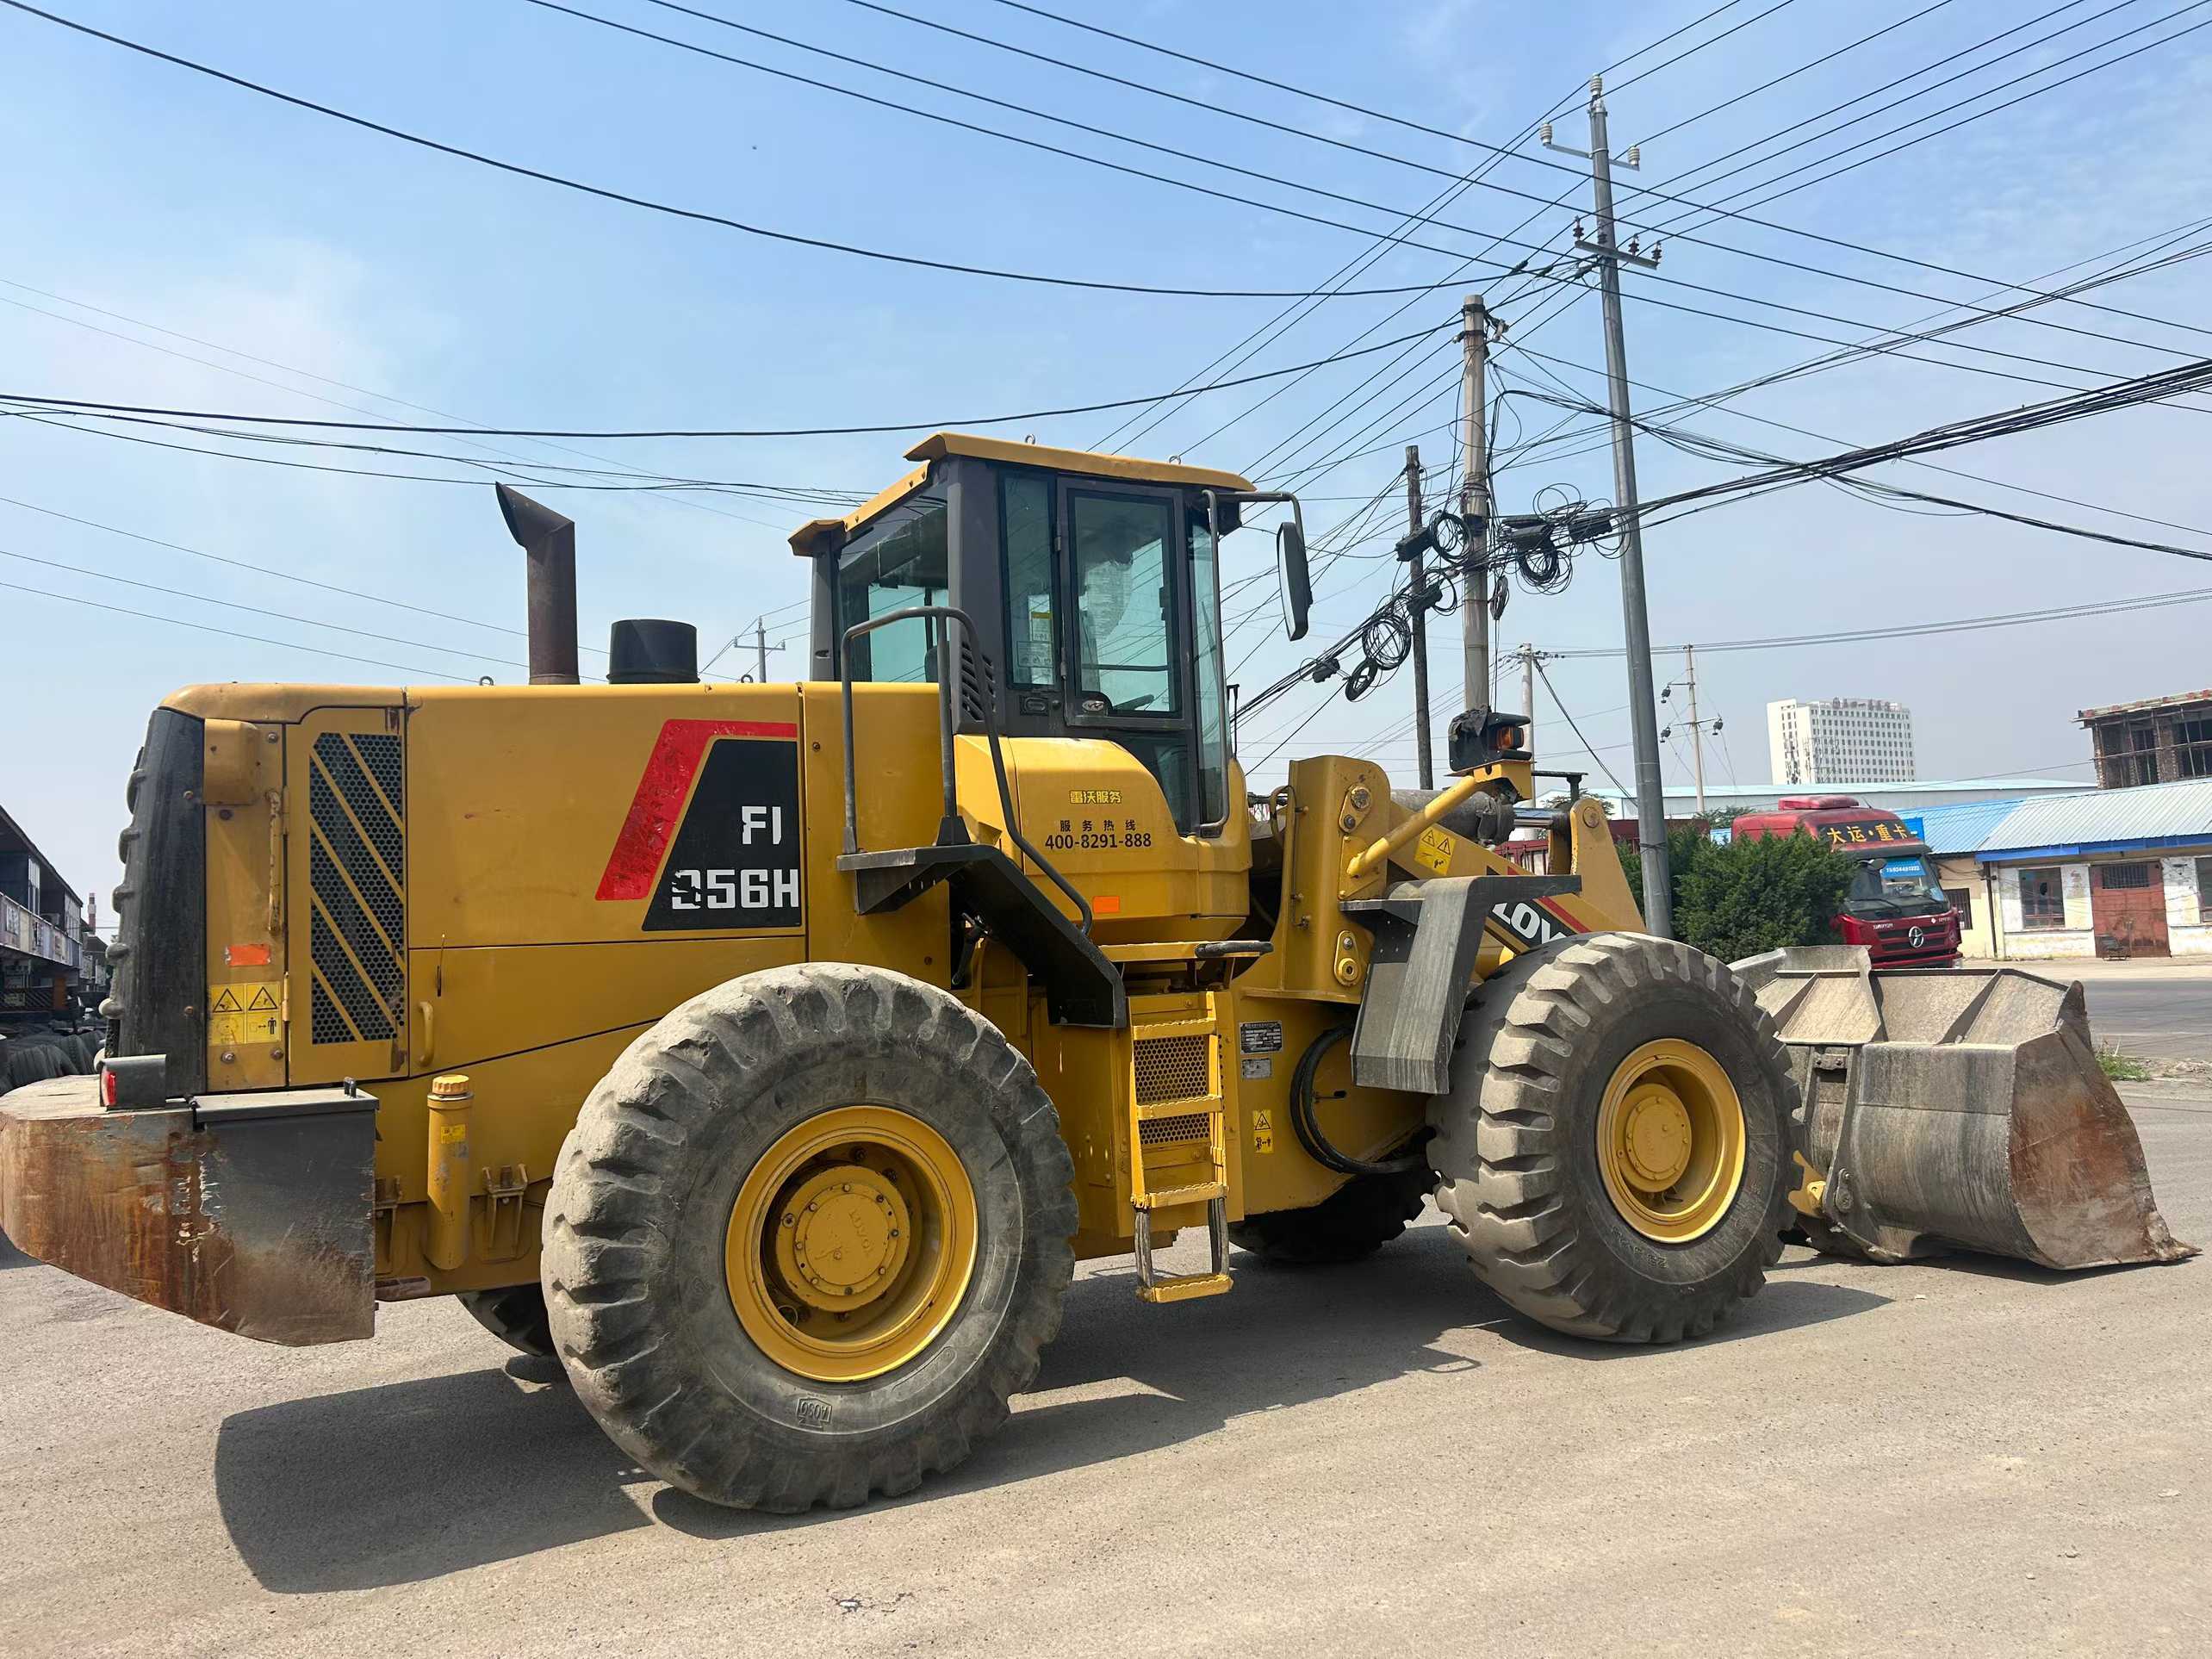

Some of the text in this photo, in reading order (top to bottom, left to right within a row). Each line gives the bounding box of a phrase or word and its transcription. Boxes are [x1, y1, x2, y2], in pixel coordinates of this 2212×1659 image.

[1070, 791, 1122, 804] 雷沃服务
[1059, 819, 1136, 832] 服务热线
[1045, 833, 1152, 849] 400-8291-888
